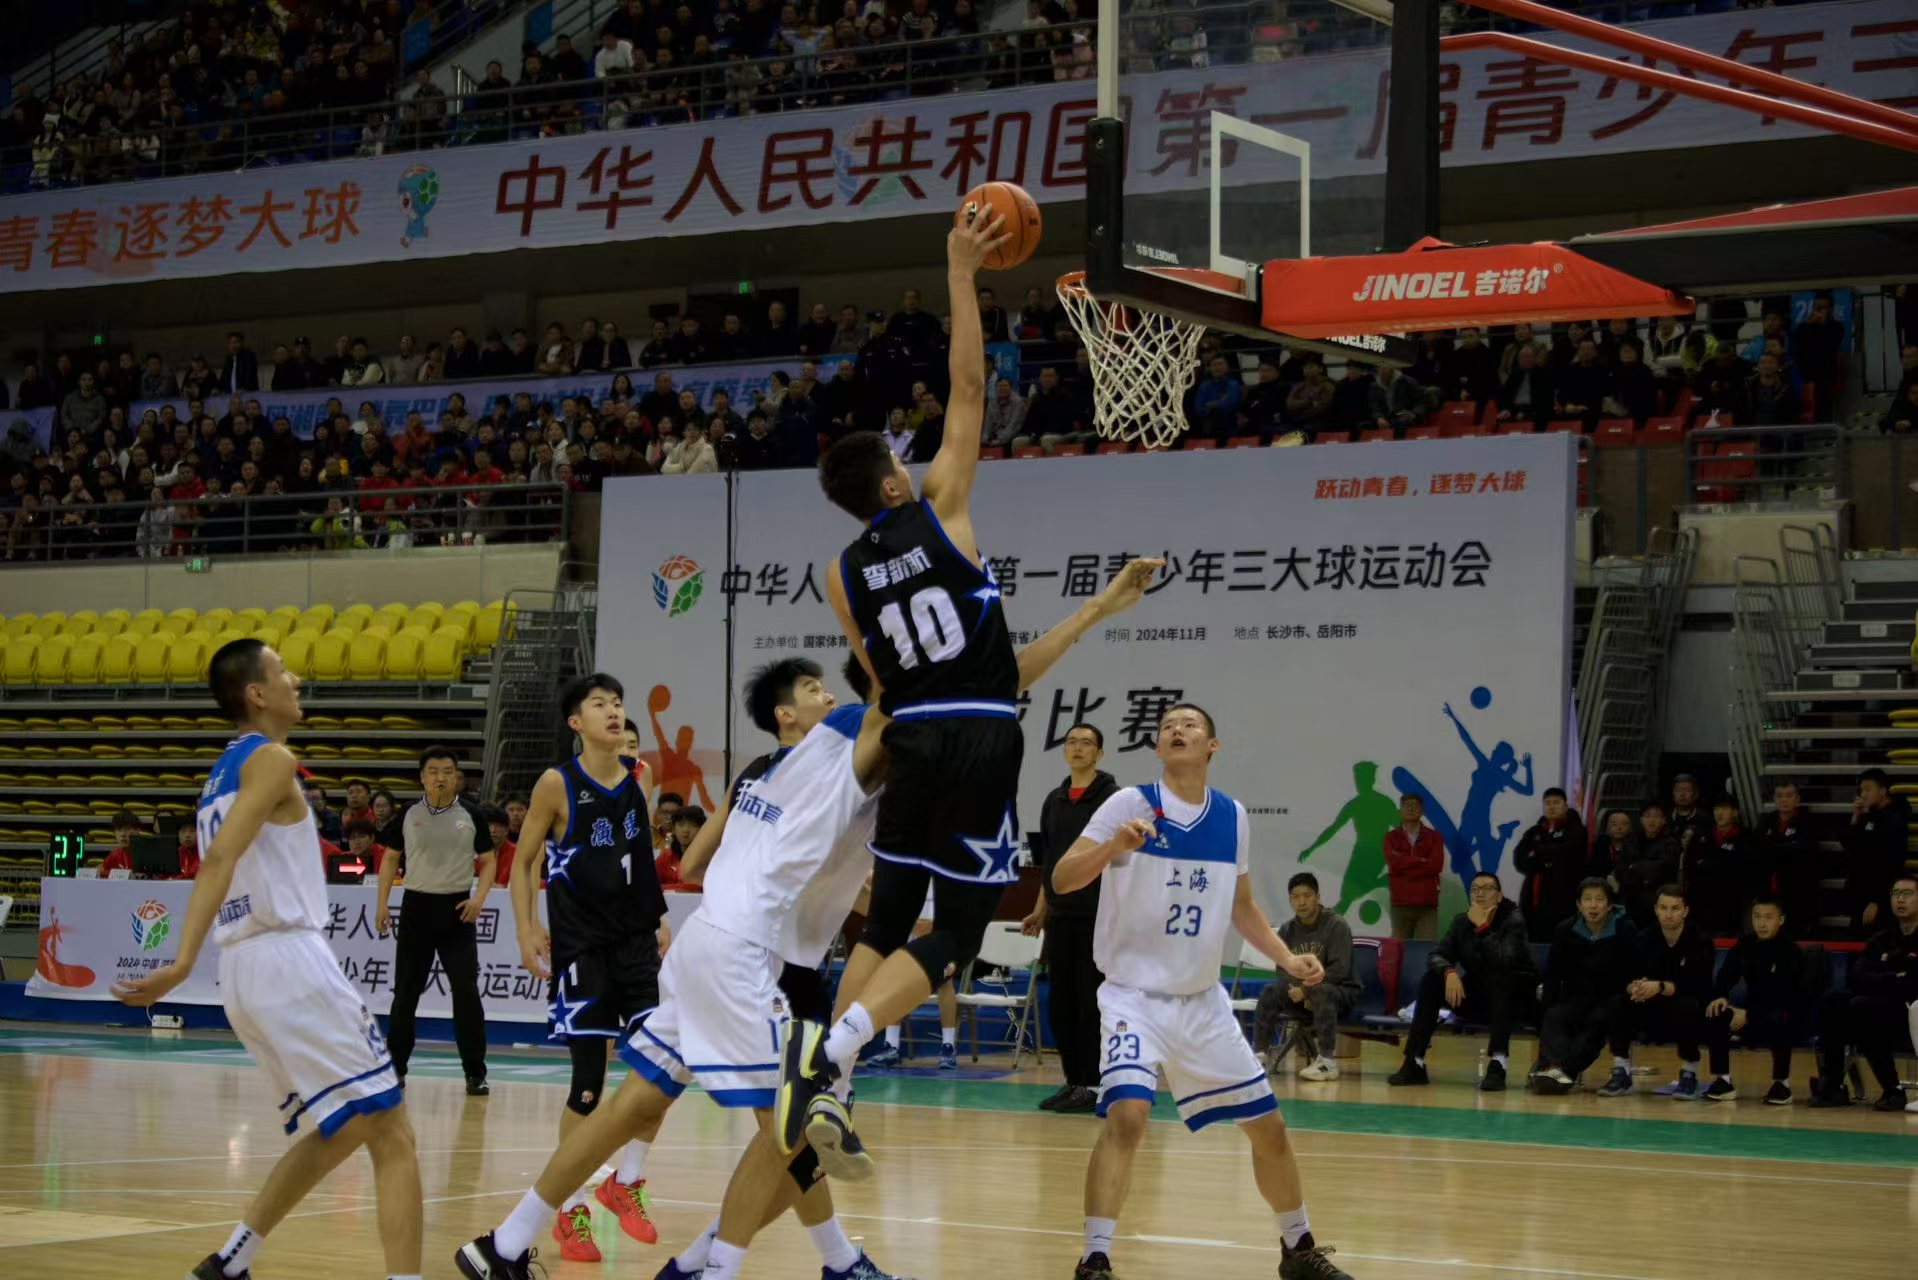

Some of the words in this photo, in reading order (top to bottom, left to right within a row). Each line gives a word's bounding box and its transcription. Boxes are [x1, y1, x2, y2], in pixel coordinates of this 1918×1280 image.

[0, 182, 362, 272] 青春逐梦大球
[1353, 271, 1470, 301] JINOEL
[1475, 267, 1549, 296] 吉诺尔
[720, 563, 824, 606] 中华人
[754, 635, 798, 649] 主办单位
[877, 585, 967, 671] 10
[1105, 629, 1130, 642] 时间
[1136, 627, 1206, 641] 2024年11月
[1234, 626, 1260, 640] 地点
[1266, 624, 1357, 639] 长沙市、岳阳市
[1016, 687, 1184, 753] 比赛
[620, 852, 633, 886] 1
[1166, 867, 1209, 893] 上海
[1165, 903, 1203, 937] 23
[116, 956, 140, 968] 2024
[568, 961, 579, 988] 1
[1107, 1033, 1140, 1064] 23
